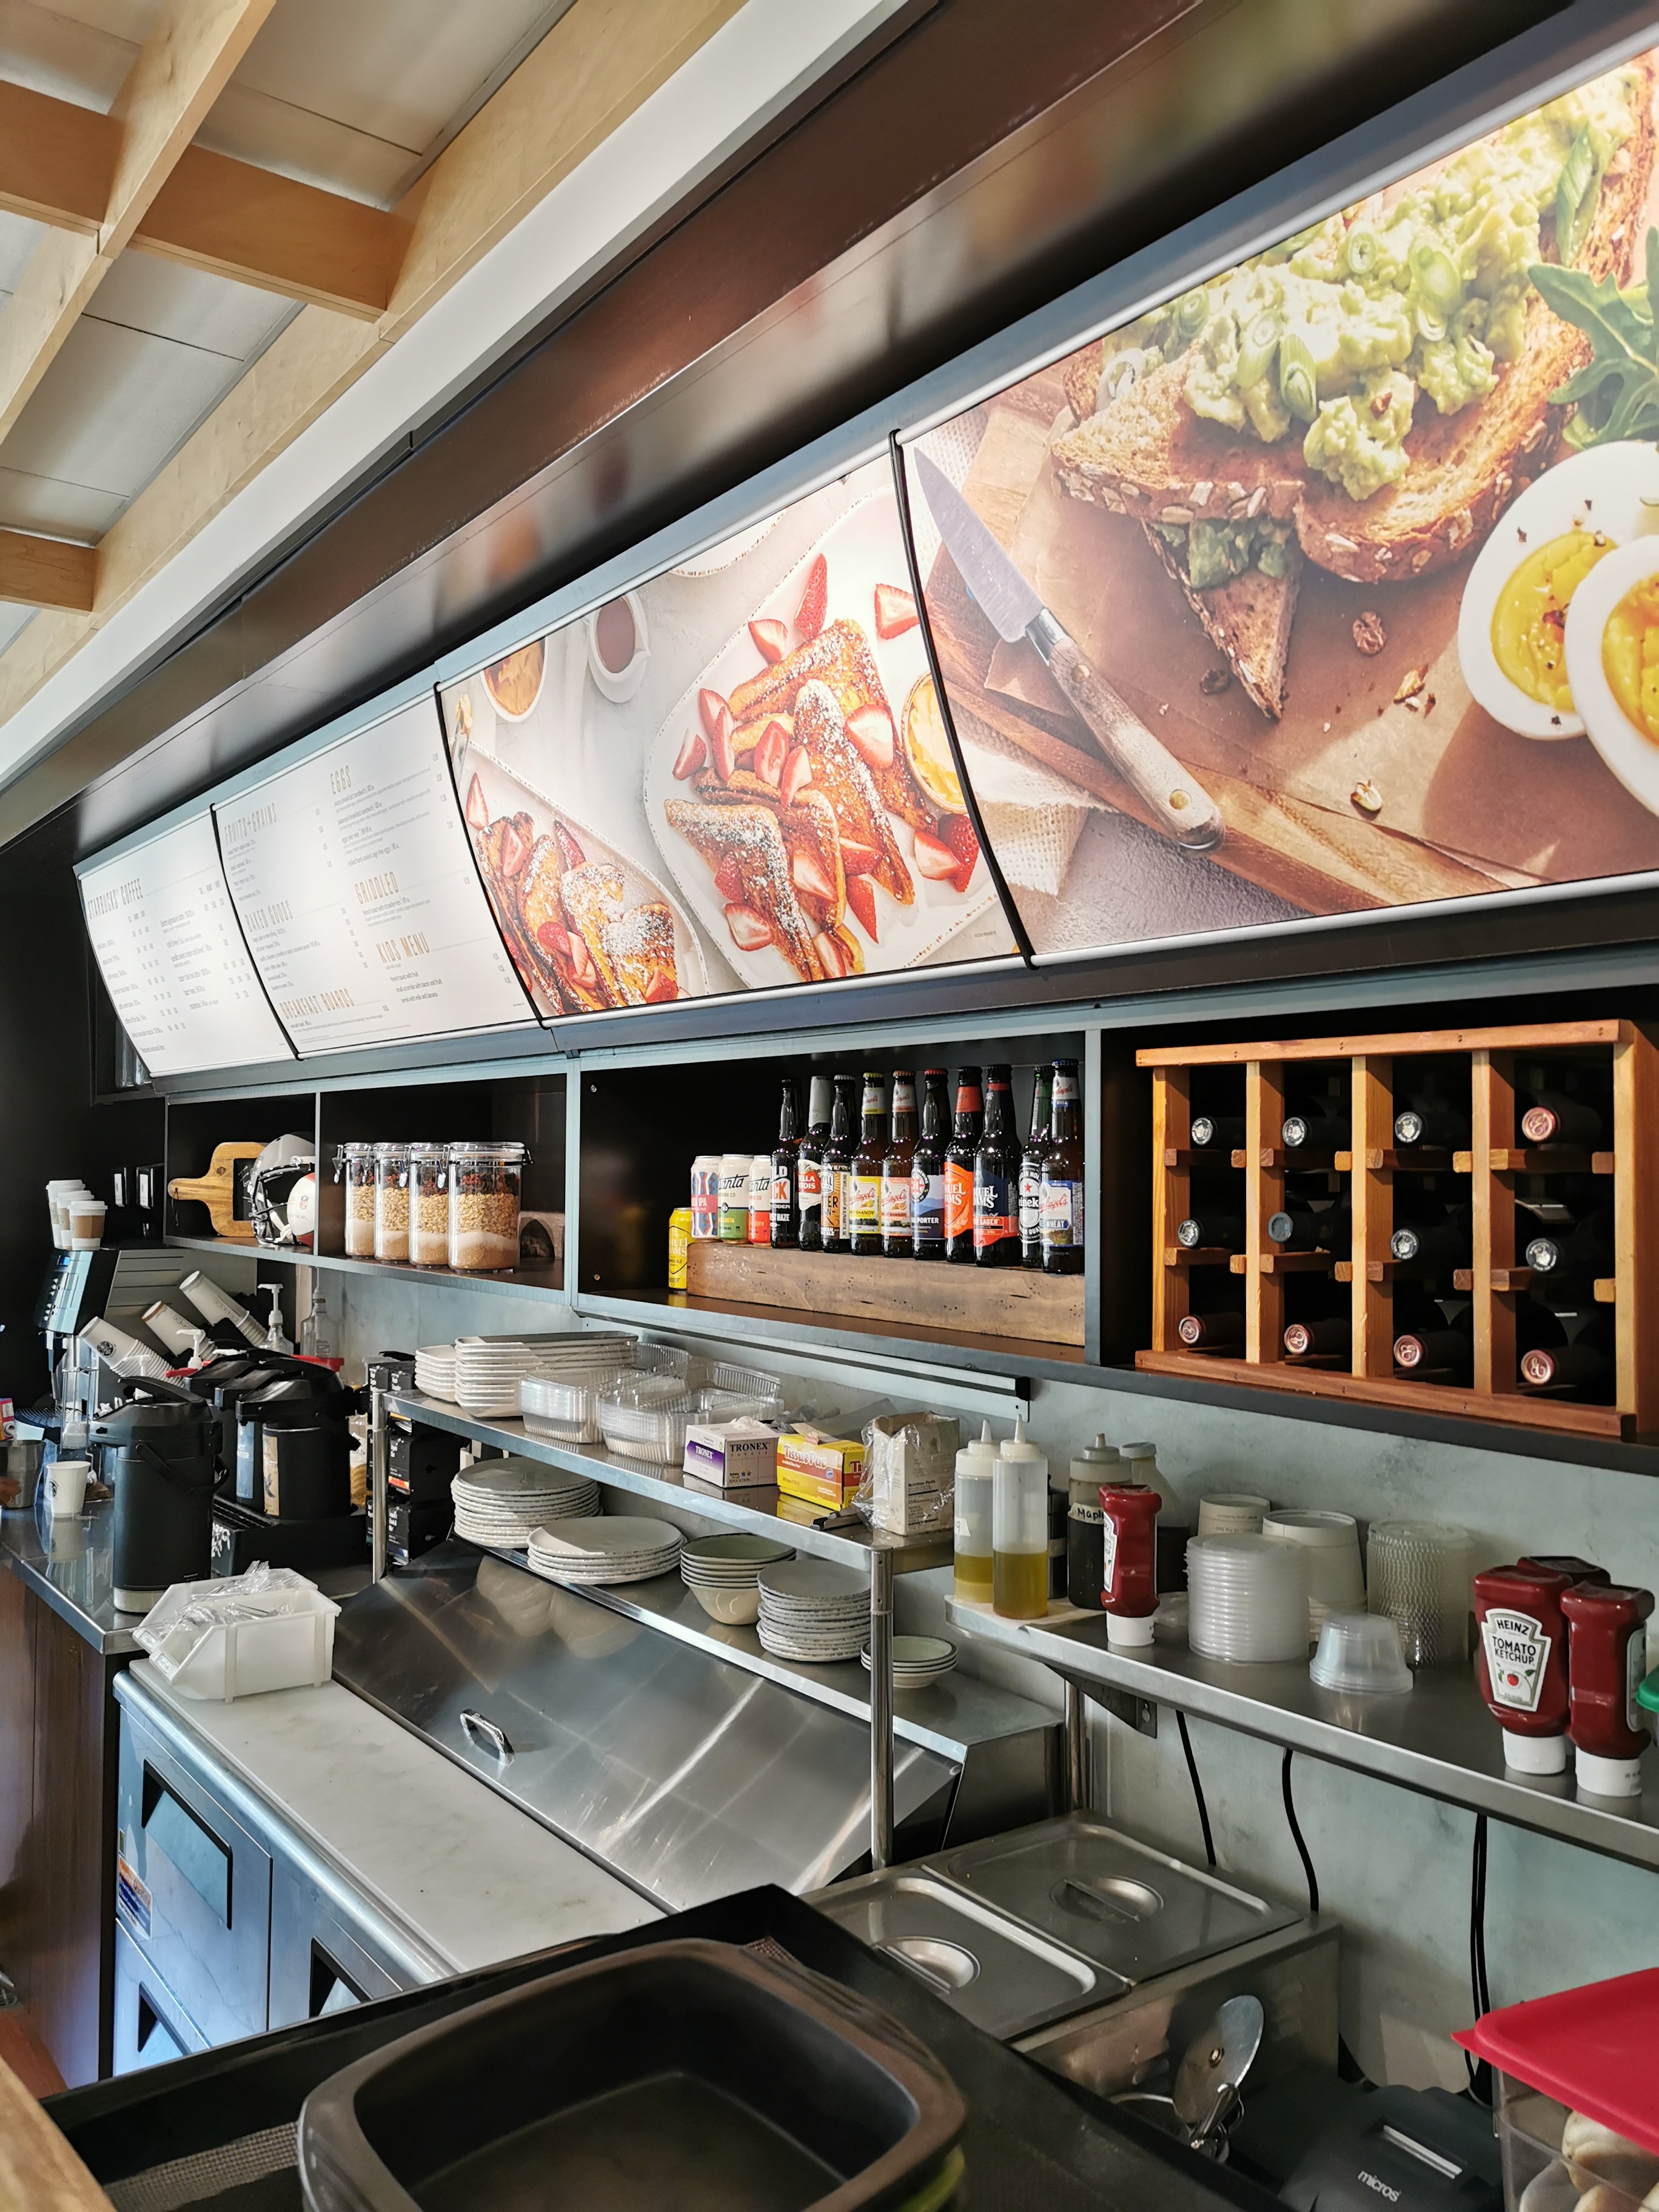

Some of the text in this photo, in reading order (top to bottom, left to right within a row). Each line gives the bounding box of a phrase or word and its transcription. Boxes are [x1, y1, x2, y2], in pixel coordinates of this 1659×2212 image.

[330, 765, 351, 795] EGGS
[121, 878, 143, 905] COFFEE
[355, 871, 399, 904] GRIDDLED
[245, 900, 293, 933] BAKED GOODS
[376, 931, 430, 964] KIDS MENU
[279, 988, 355, 1019] BREAKFAST BOARDS
[770, 1165, 788, 1180] LD
[770, 1182, 788, 1200] CK
[1019, 1197, 1039, 1207] einek
[695, 1446, 713, 1460] TRONEX
[729, 1442, 768, 1452] TRONEX
[1078, 1507, 1104, 1523] Mapl
[1496, 1620, 1529, 1635] HEINZ
[1492, 1636, 1536, 1656] TOMATO
[1495, 1648, 1534, 1664] KETCHUP
[1358, 2170, 1398, 2202] micros
